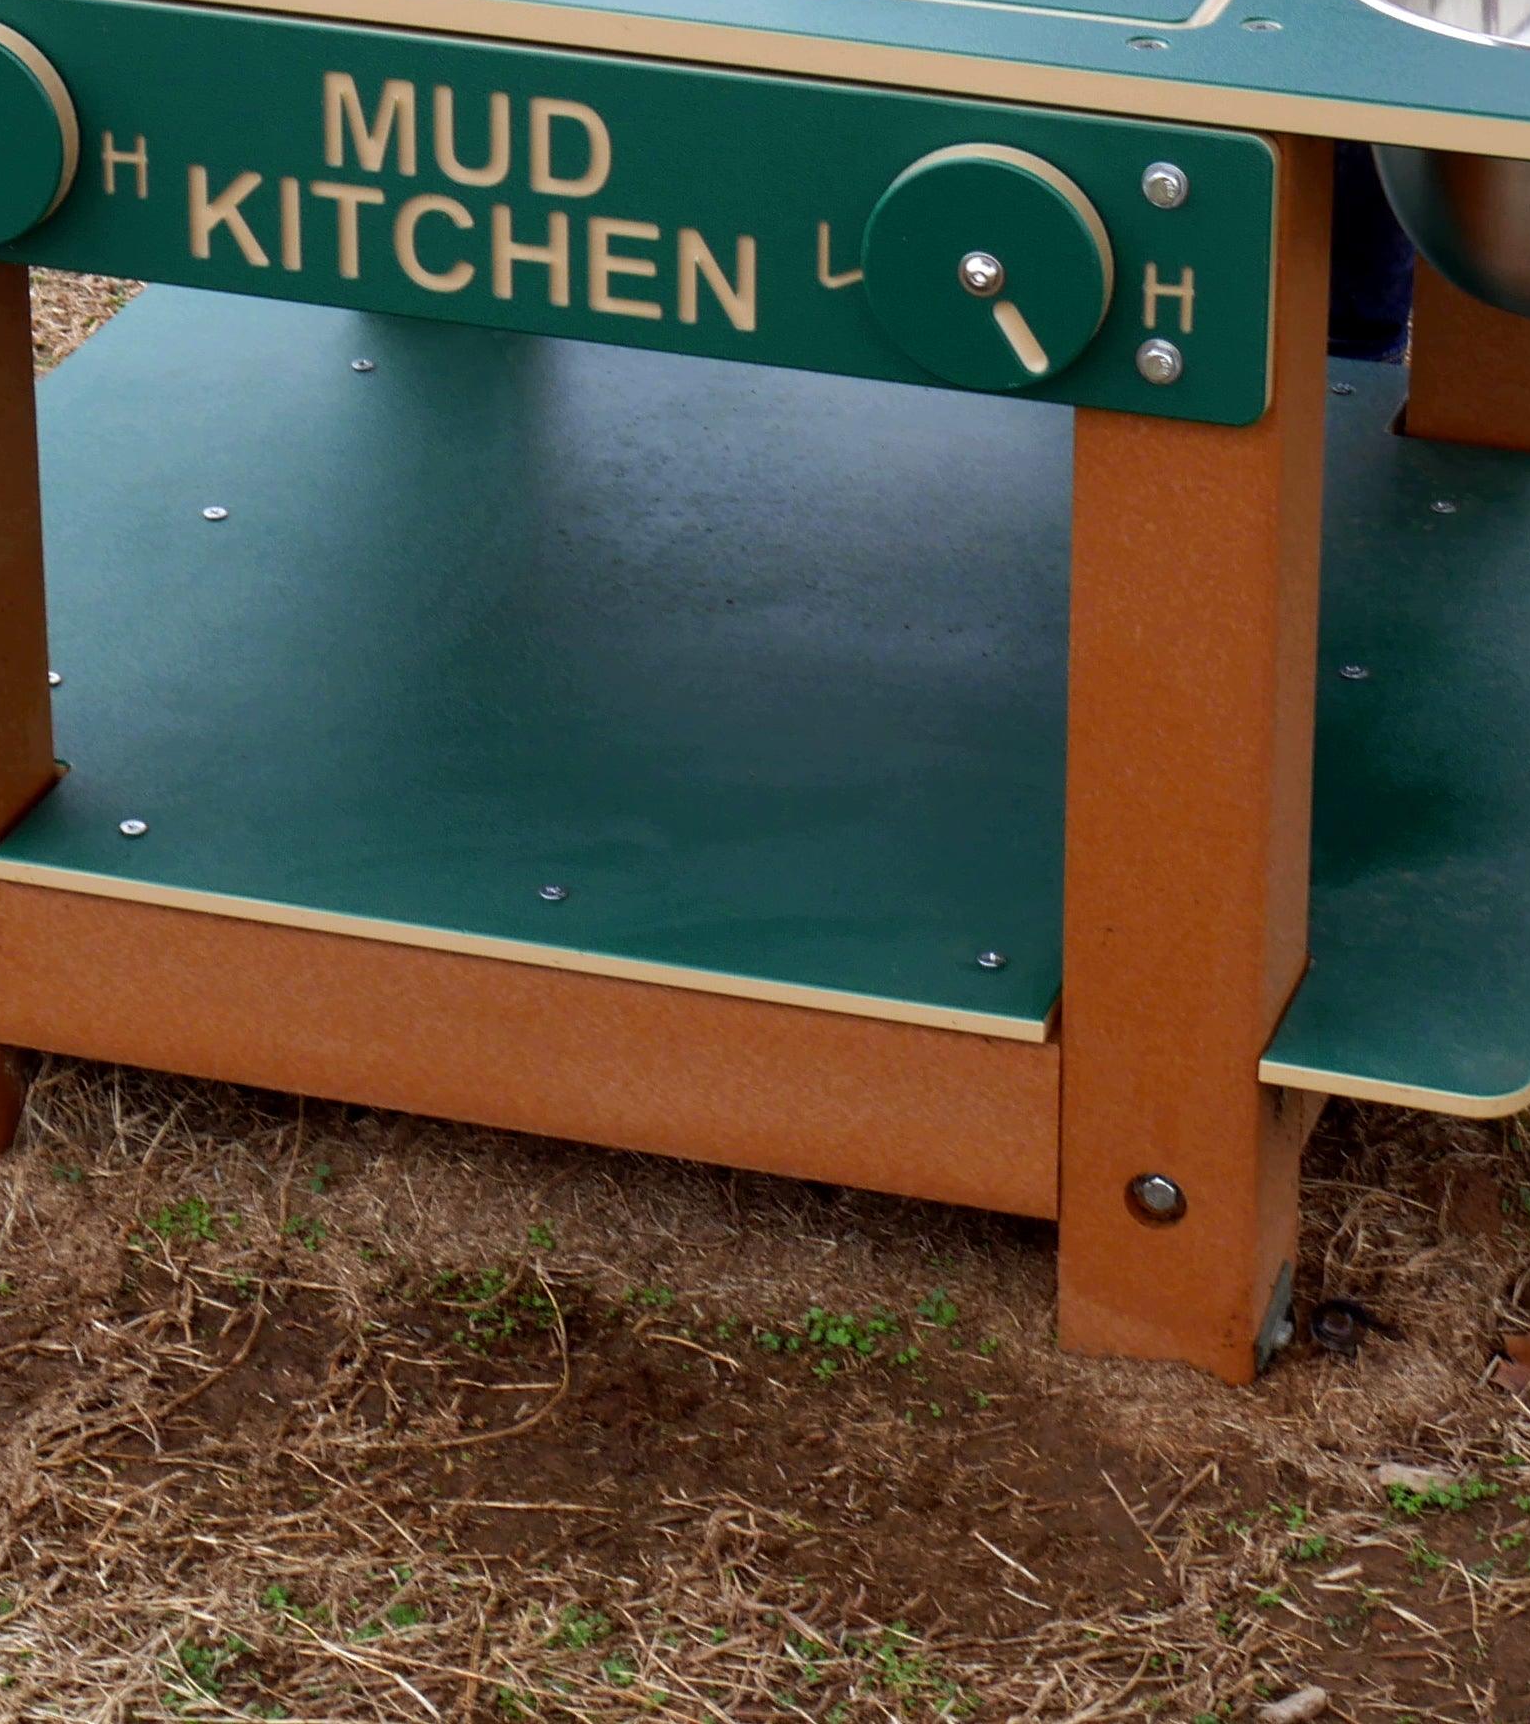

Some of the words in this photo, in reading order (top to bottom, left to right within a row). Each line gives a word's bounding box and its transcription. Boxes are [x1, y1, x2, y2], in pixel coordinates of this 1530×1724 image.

[101, 130, 149, 199] H
[323, 71, 612, 198] MUD
[187, 164, 758, 333] KITCHEN
[1143, 262, 1196, 333] H
